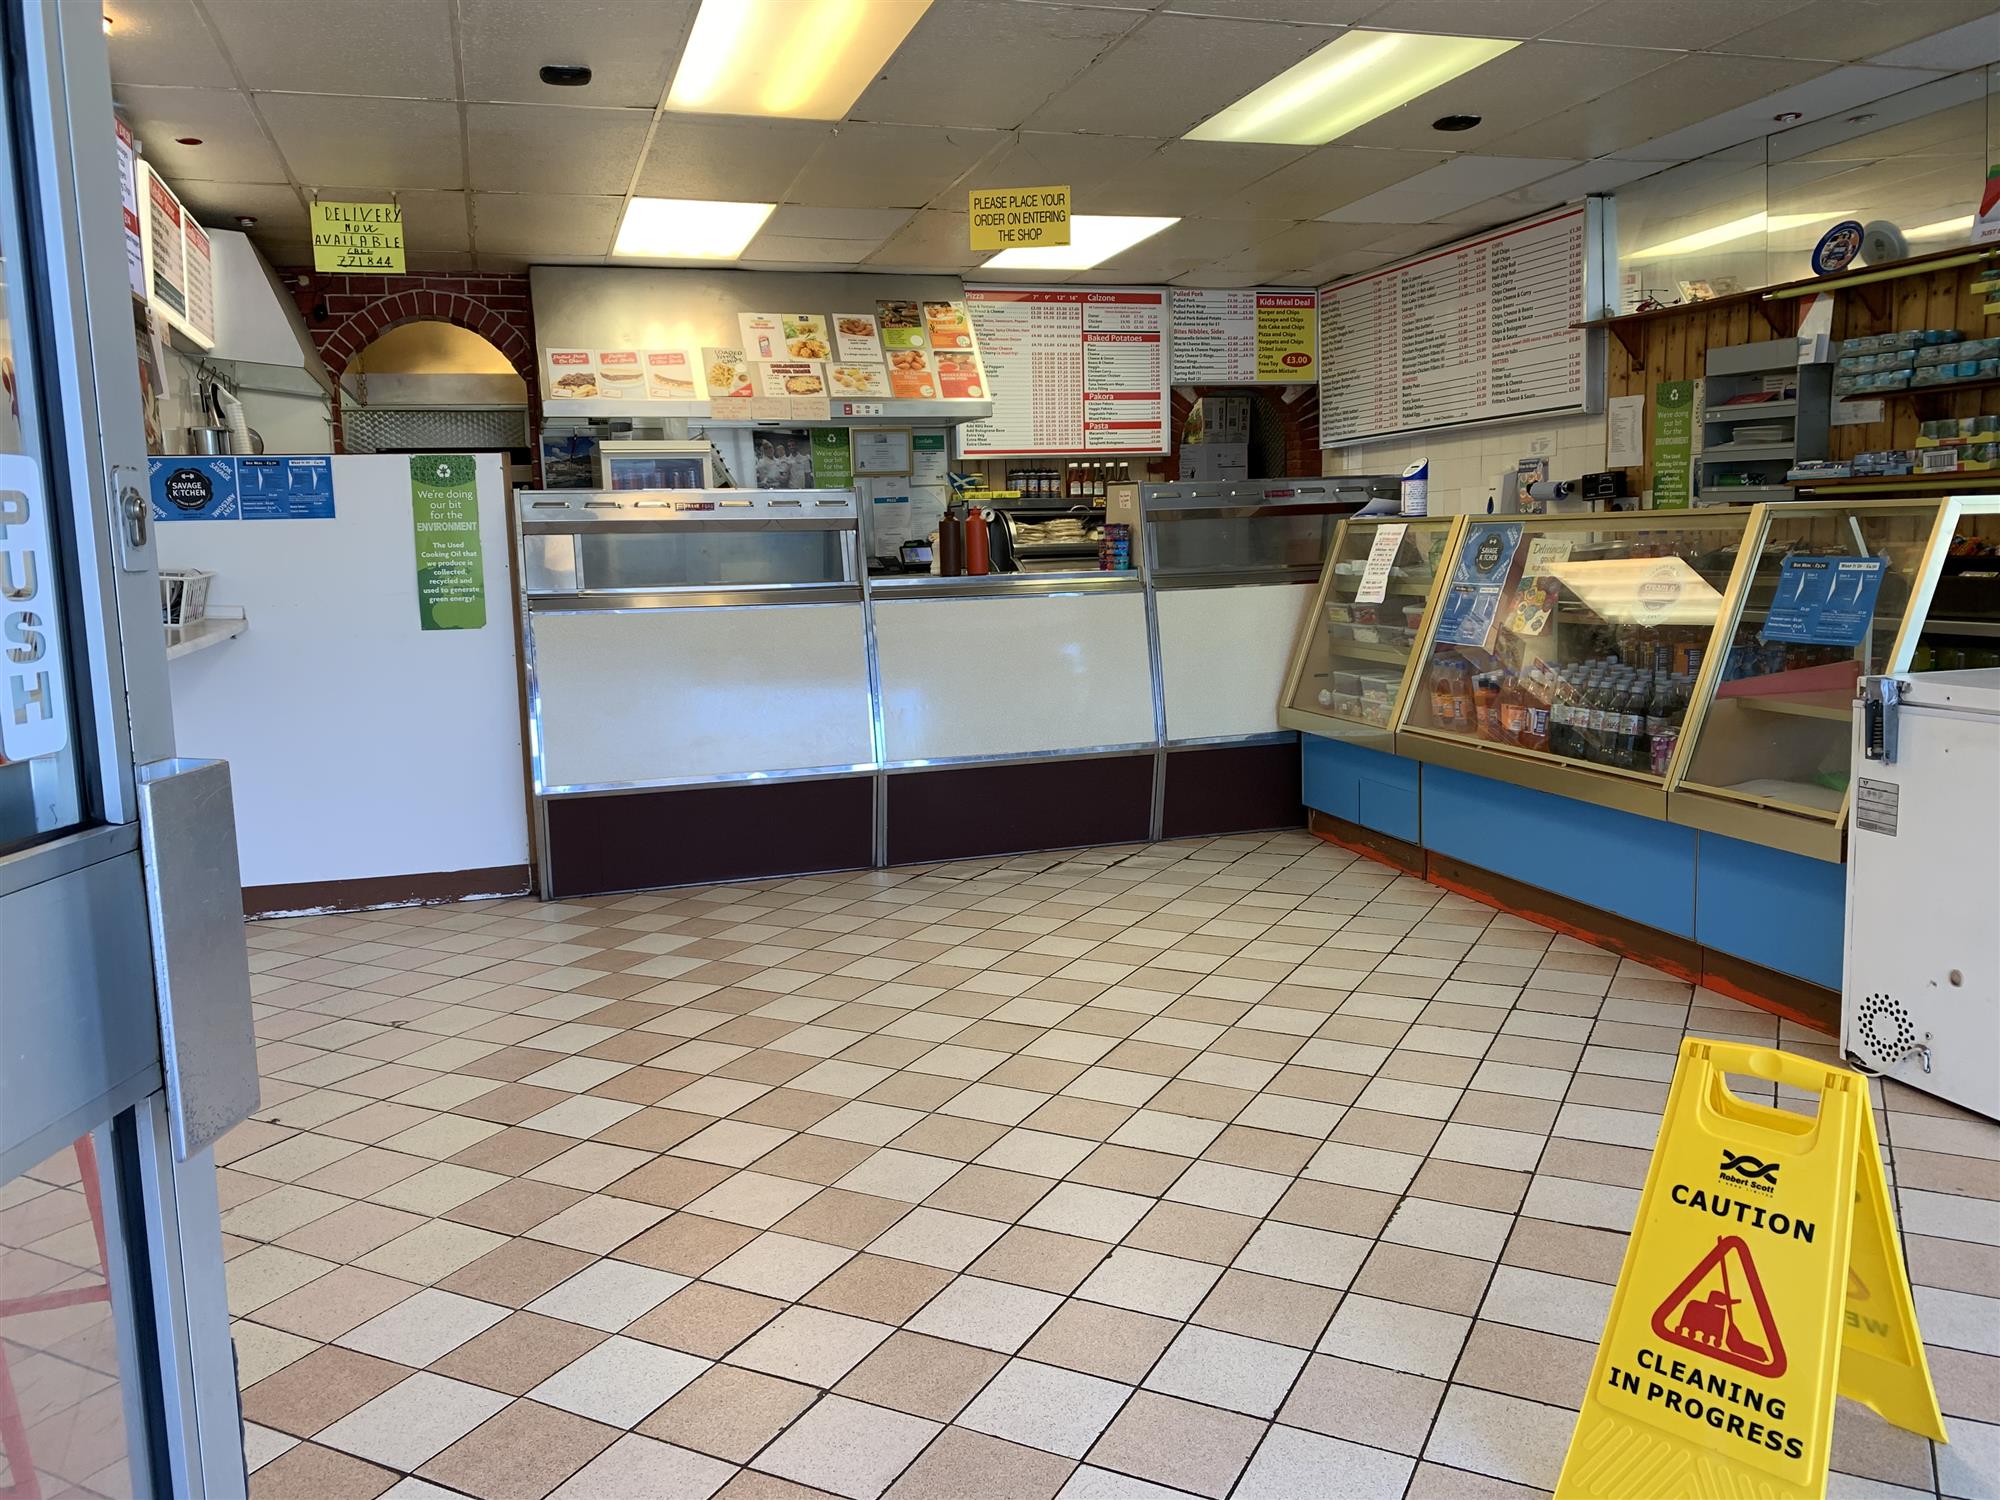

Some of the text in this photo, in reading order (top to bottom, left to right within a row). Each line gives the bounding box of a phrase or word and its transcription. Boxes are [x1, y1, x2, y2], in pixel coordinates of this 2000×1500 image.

[974, 194, 1065, 210] PLEASE PLACE YOUR
[325, 206, 401, 222] DELIVERY
[974, 210, 1066, 226] ORDER ON ENTERING
[345, 224, 378, 232] NOW
[998, 228, 1042, 242] THE SHOP
[315, 234, 400, 248] AVAILABLE
[209, 463, 231, 482] SAVAGE
[216, 460, 232, 474] LOOK
[418, 490, 473, 500] We're doing
[212, 494, 236, 518] AWESOME
[223, 503, 236, 517] STAY
[449, 500, 461, 508] bit
[430, 510, 463, 519] for the
[417, 522, 477, 532] ENVIRONMENT
[1533, 544, 1568, 556] Deliciously
[450, 595, 476, 603] energy!
[0, 490, 53, 724] PUSH
[1720, 1172, 1748, 1186] Robert
[1750, 1181, 1775, 1194] Scott
[1672, 1184, 1816, 1243] CAUTION
[1637, 1349, 1786, 1420] CLEANING
[1608, 1366, 1804, 1460] IN PROGRESS
